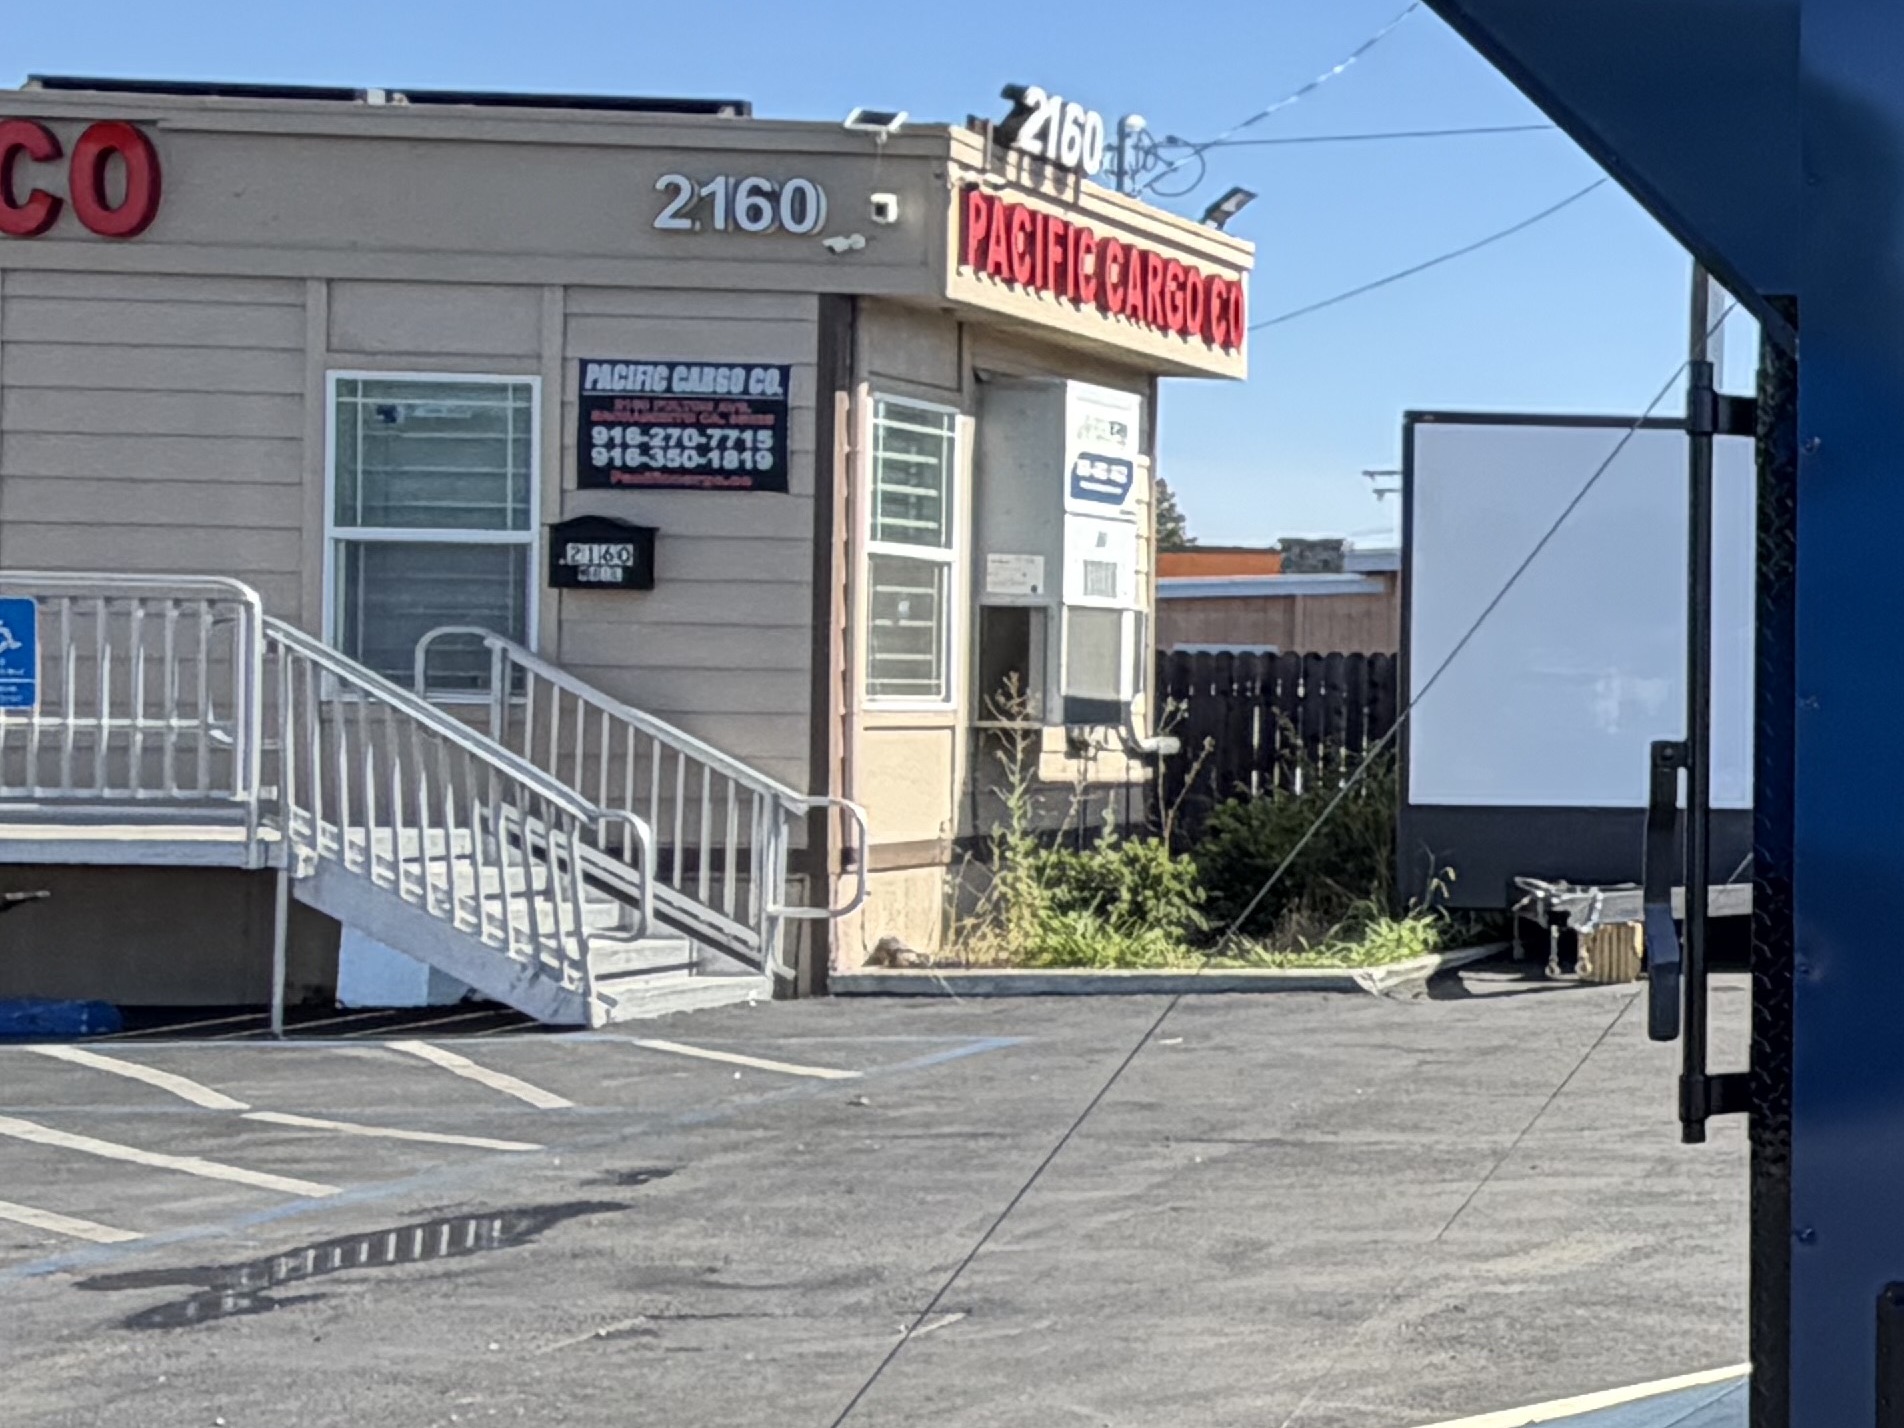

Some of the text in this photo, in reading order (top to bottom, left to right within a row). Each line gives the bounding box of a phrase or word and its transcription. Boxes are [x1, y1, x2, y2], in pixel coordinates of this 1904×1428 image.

[1013, 85, 1105, 177] 2160
[653, 173, 826, 234] 2160
[965, 186, 1245, 351] PACIFIC CARGO CO
[585, 363, 669, 392] PACIFIC
[590, 426, 774, 449] 916-270-7715
[590, 447, 774, 470] 916-350-1819
[569, 545, 631, 564] 2160
